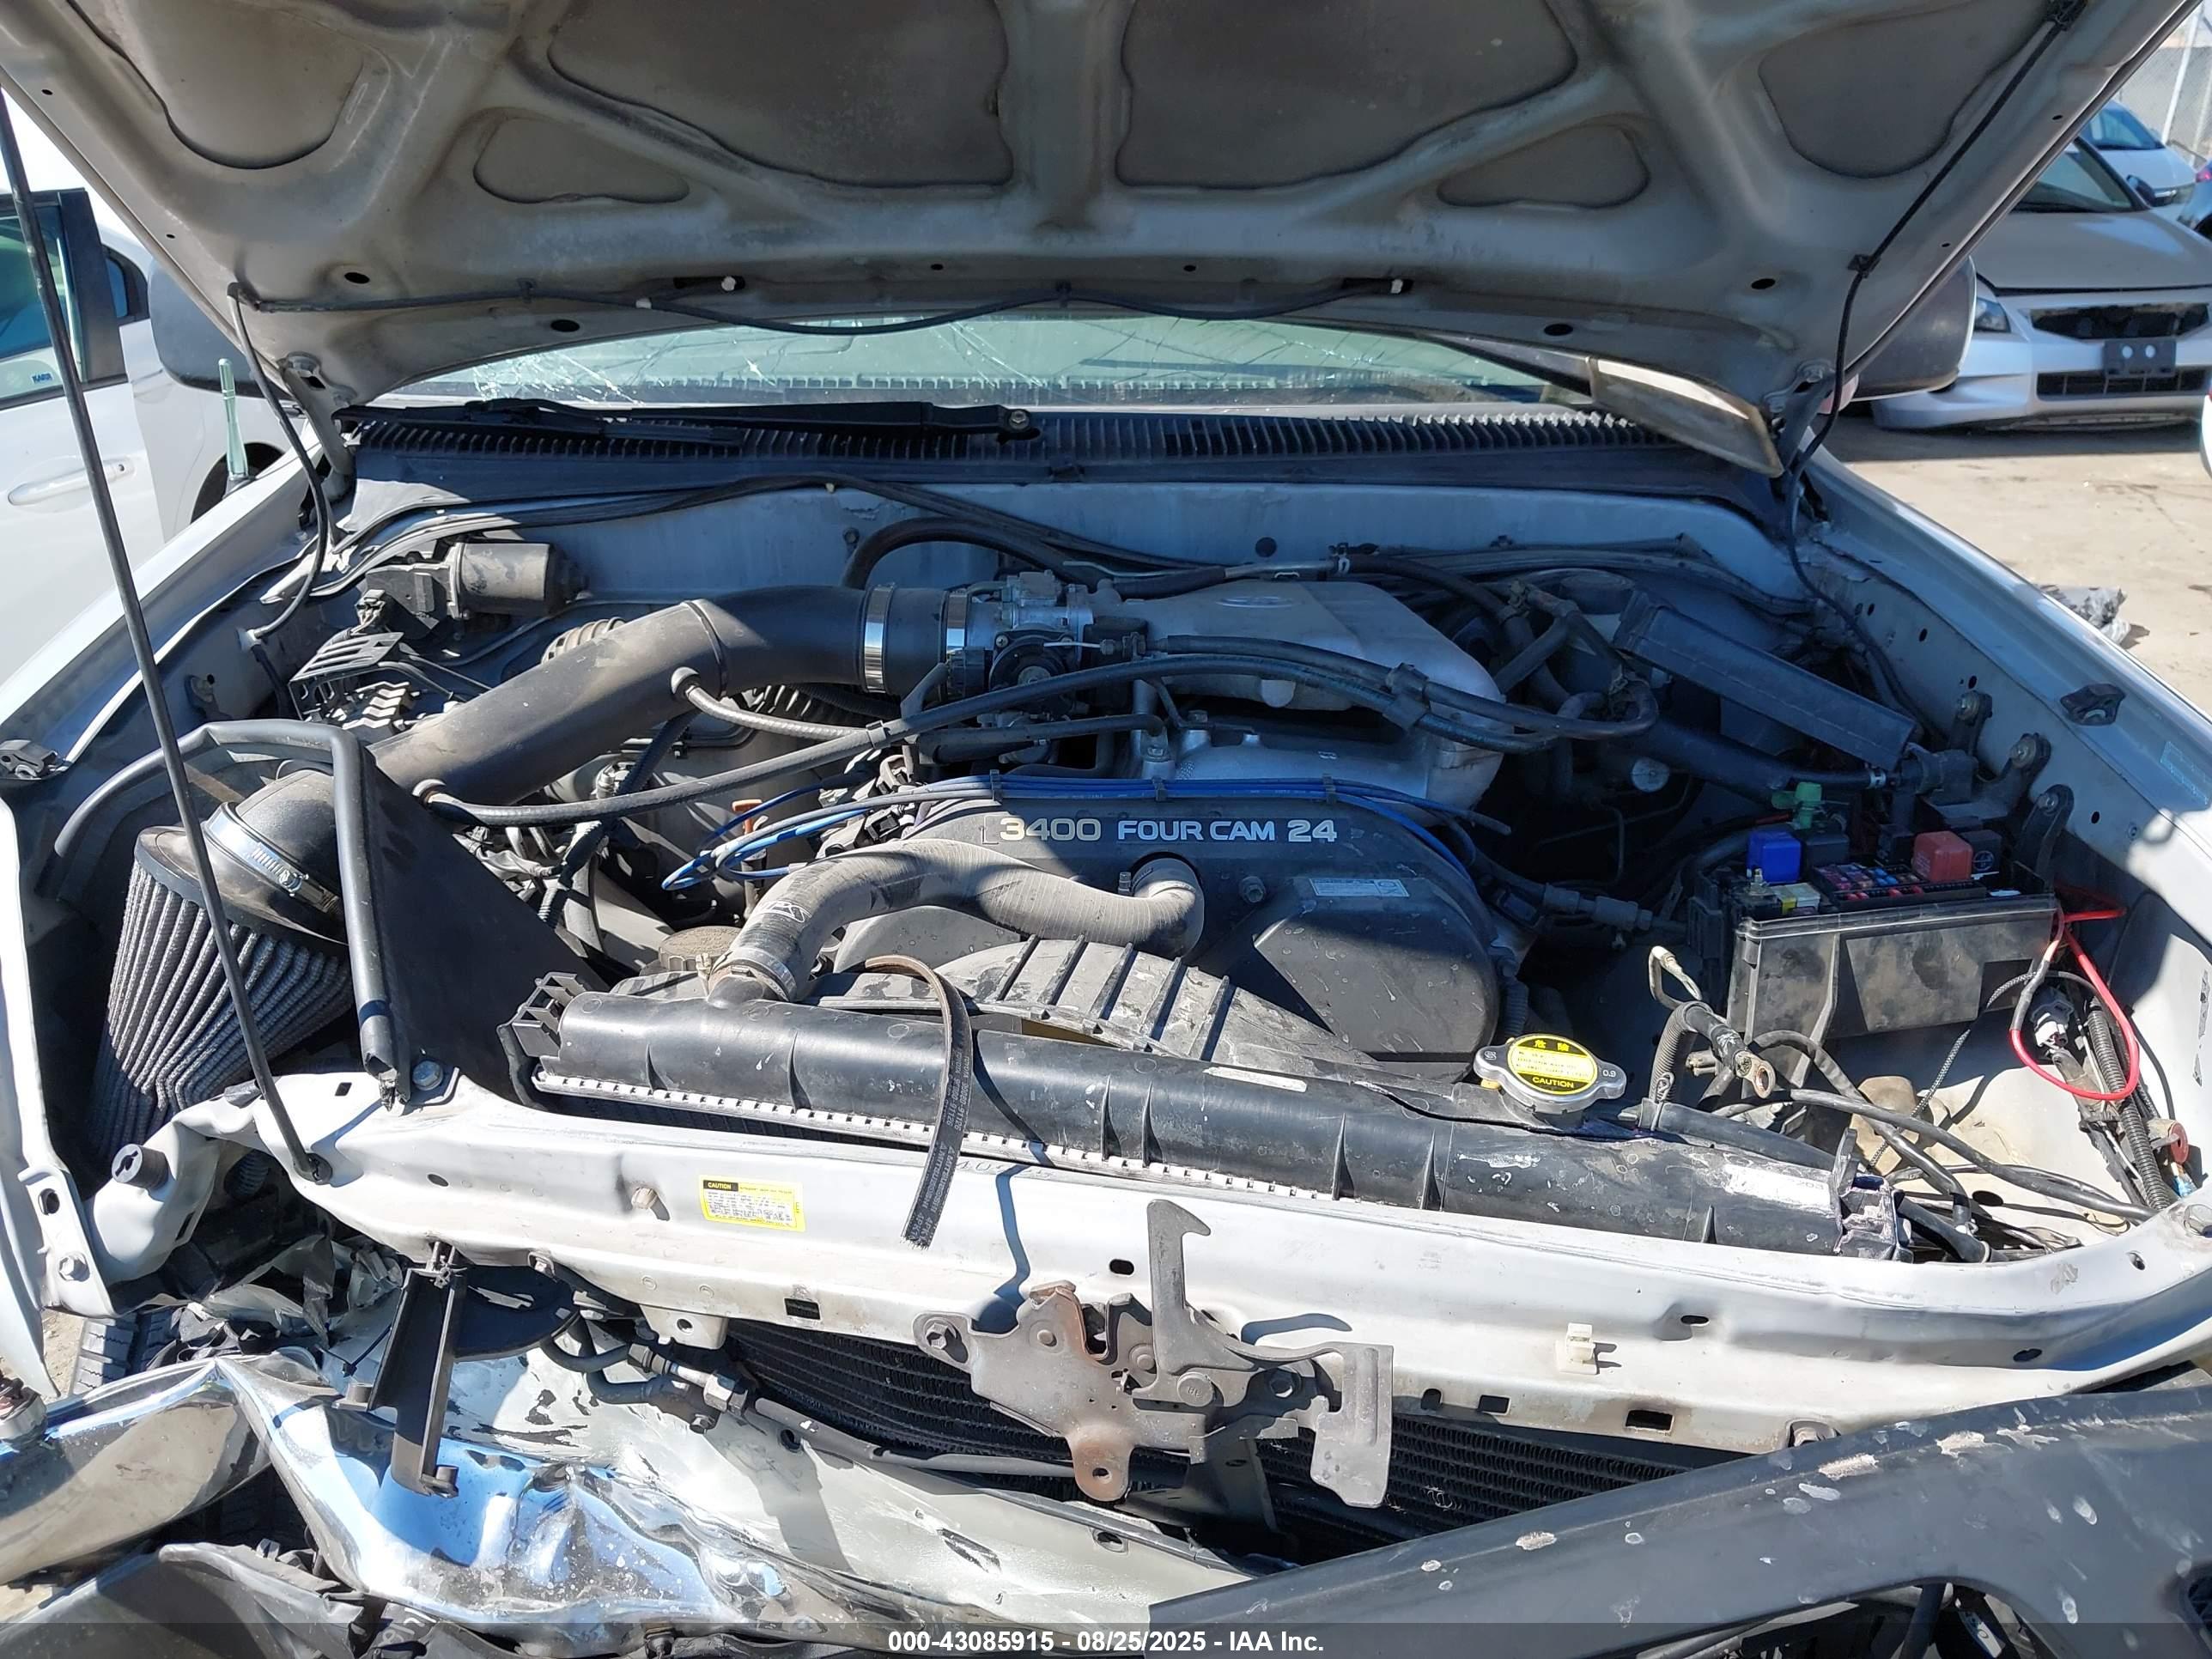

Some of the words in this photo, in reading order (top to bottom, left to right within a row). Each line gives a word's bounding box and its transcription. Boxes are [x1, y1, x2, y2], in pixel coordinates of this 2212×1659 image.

[999, 817, 1102, 842] 3400
[1117, 820, 1203, 841] FOUR
[1209, 820, 1276, 842] CAM
[1287, 819, 1338, 842] 24
[1602, 1069, 1617, 1078] 0.9
[1532, 1077, 1575, 1088] CAUTION
